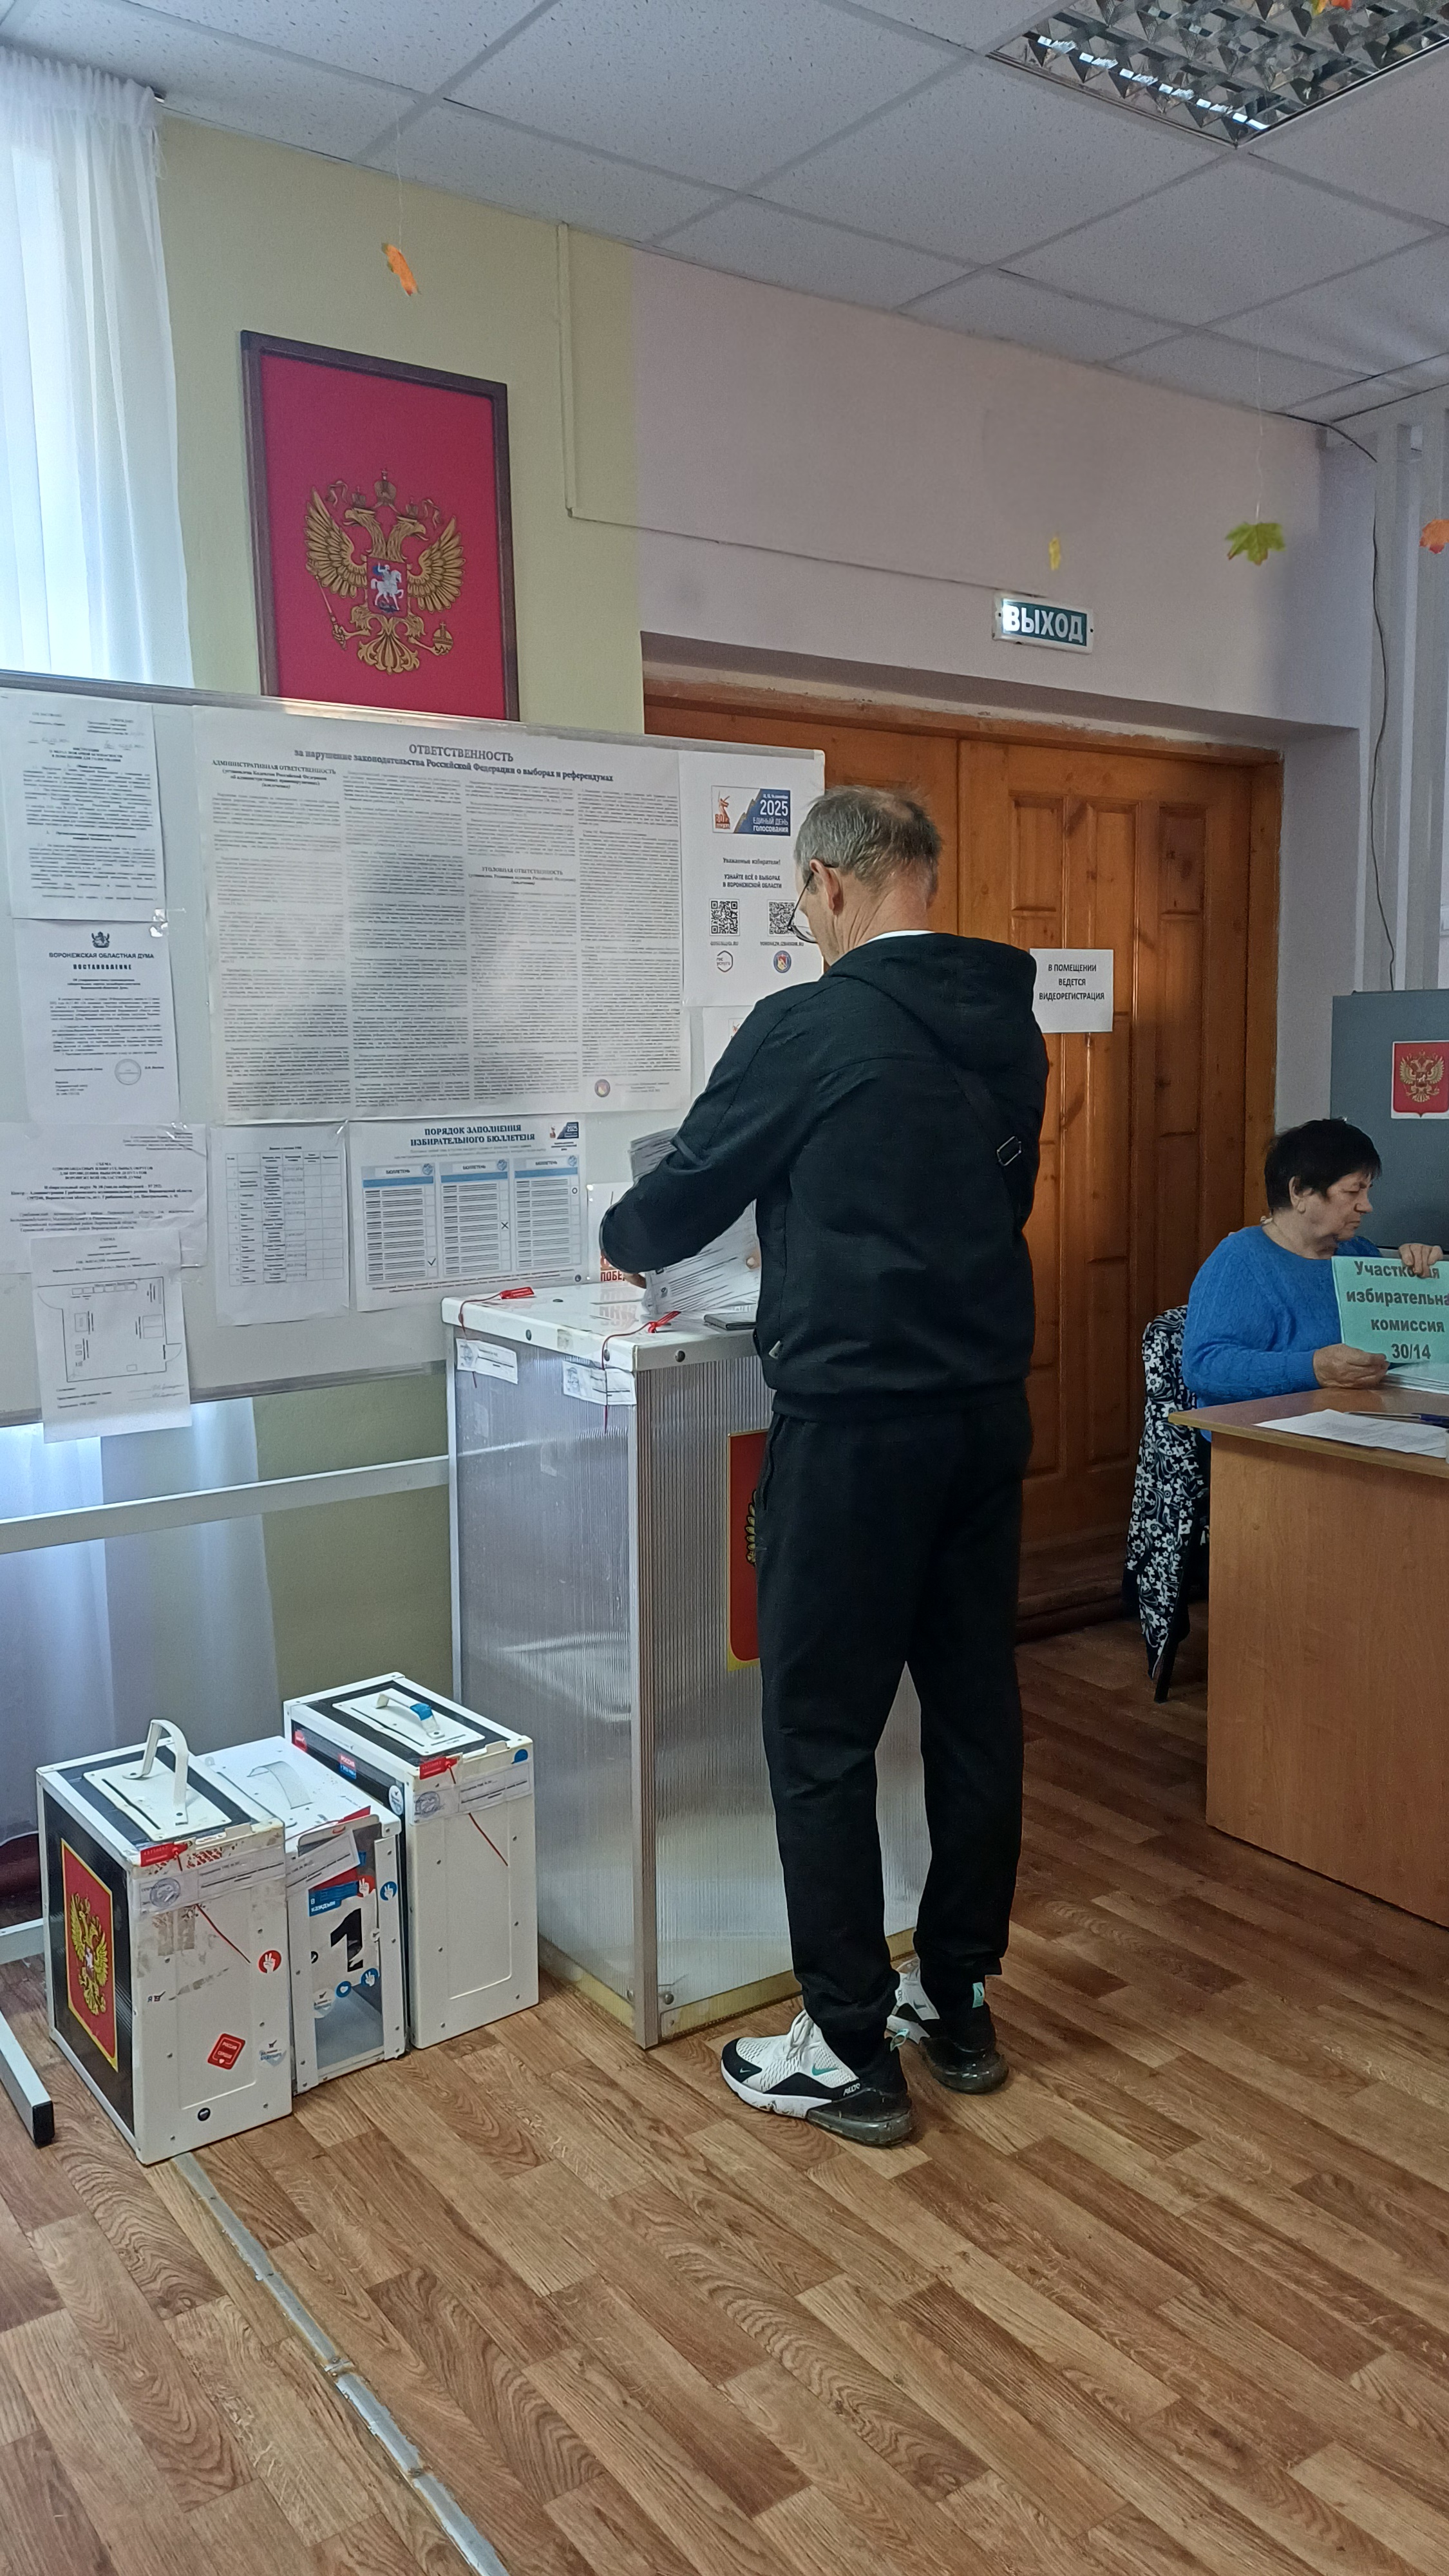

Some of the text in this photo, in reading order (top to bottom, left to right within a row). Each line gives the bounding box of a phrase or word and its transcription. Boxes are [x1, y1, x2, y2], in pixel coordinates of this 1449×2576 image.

[1002, 604, 1083, 643] ВЫХОД
[409, 744, 514, 762] ОТВЕТСТВЕННОСТЬ
[279, 765, 336, 775] ОТВЕТСТВЕННОСТЬ
[305, 750, 352, 761] нарушение
[354, 754, 424, 766] законодательства
[426, 759, 471, 770] Российской
[473, 762, 515, 775] Федерации
[523, 767, 556, 778] выборах
[562, 771, 614, 782] референдумах
[760, 799, 788, 817] 2025
[753, 817, 774, 825] ЕДИНЫЙ
[1054, 964, 1097, 973] ПОМЕЩЕНИИ
[1058, 978, 1086, 987] ВЕДЕТСЯ
[1039, 992, 1104, 1001] ВИДЕОРЕГИСТРАЦИЯ
[424, 1124, 522, 1136] ПОРЯДОК ЗАПОЛНЕНИЯ
[410, 1133, 535, 1146] ИЗБИРАТЕЛЬНОГО БЮЛЛЕТЕНЯ
[600, 1270, 625, 1282] ПОБЕ
[1354, 1260, 1440, 1279] Участкоя
[1370, 1319, 1445, 1332] комиссия
[1391, 1343, 1431, 1359] 30/14
